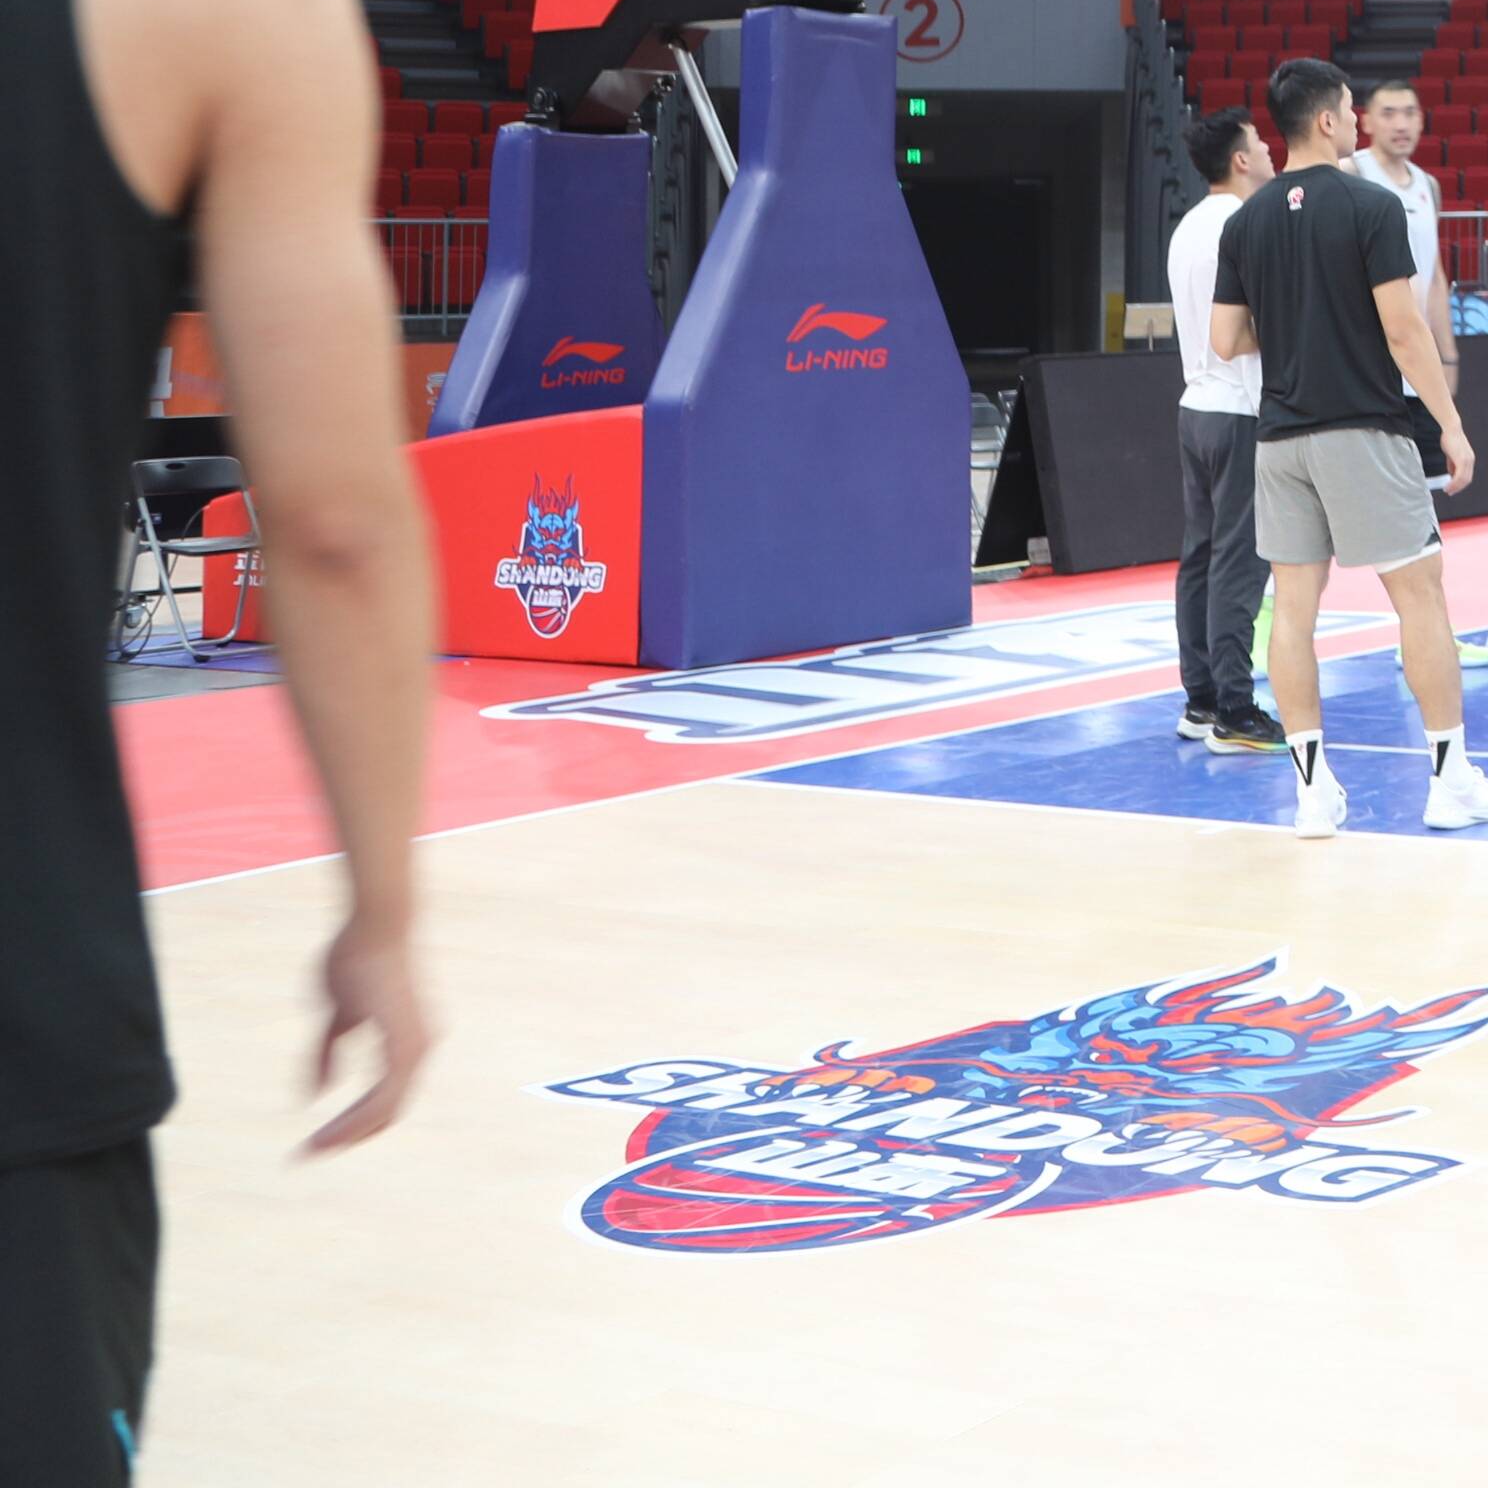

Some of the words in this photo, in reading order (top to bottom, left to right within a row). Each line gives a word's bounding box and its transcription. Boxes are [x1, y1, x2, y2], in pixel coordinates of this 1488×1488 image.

[786, 348, 888, 372] LI-NING
[540, 368, 625, 388] LI-NING
[498, 564, 603, 588] SHANDONG
[592, 1062, 1396, 1196] SHANDONG
